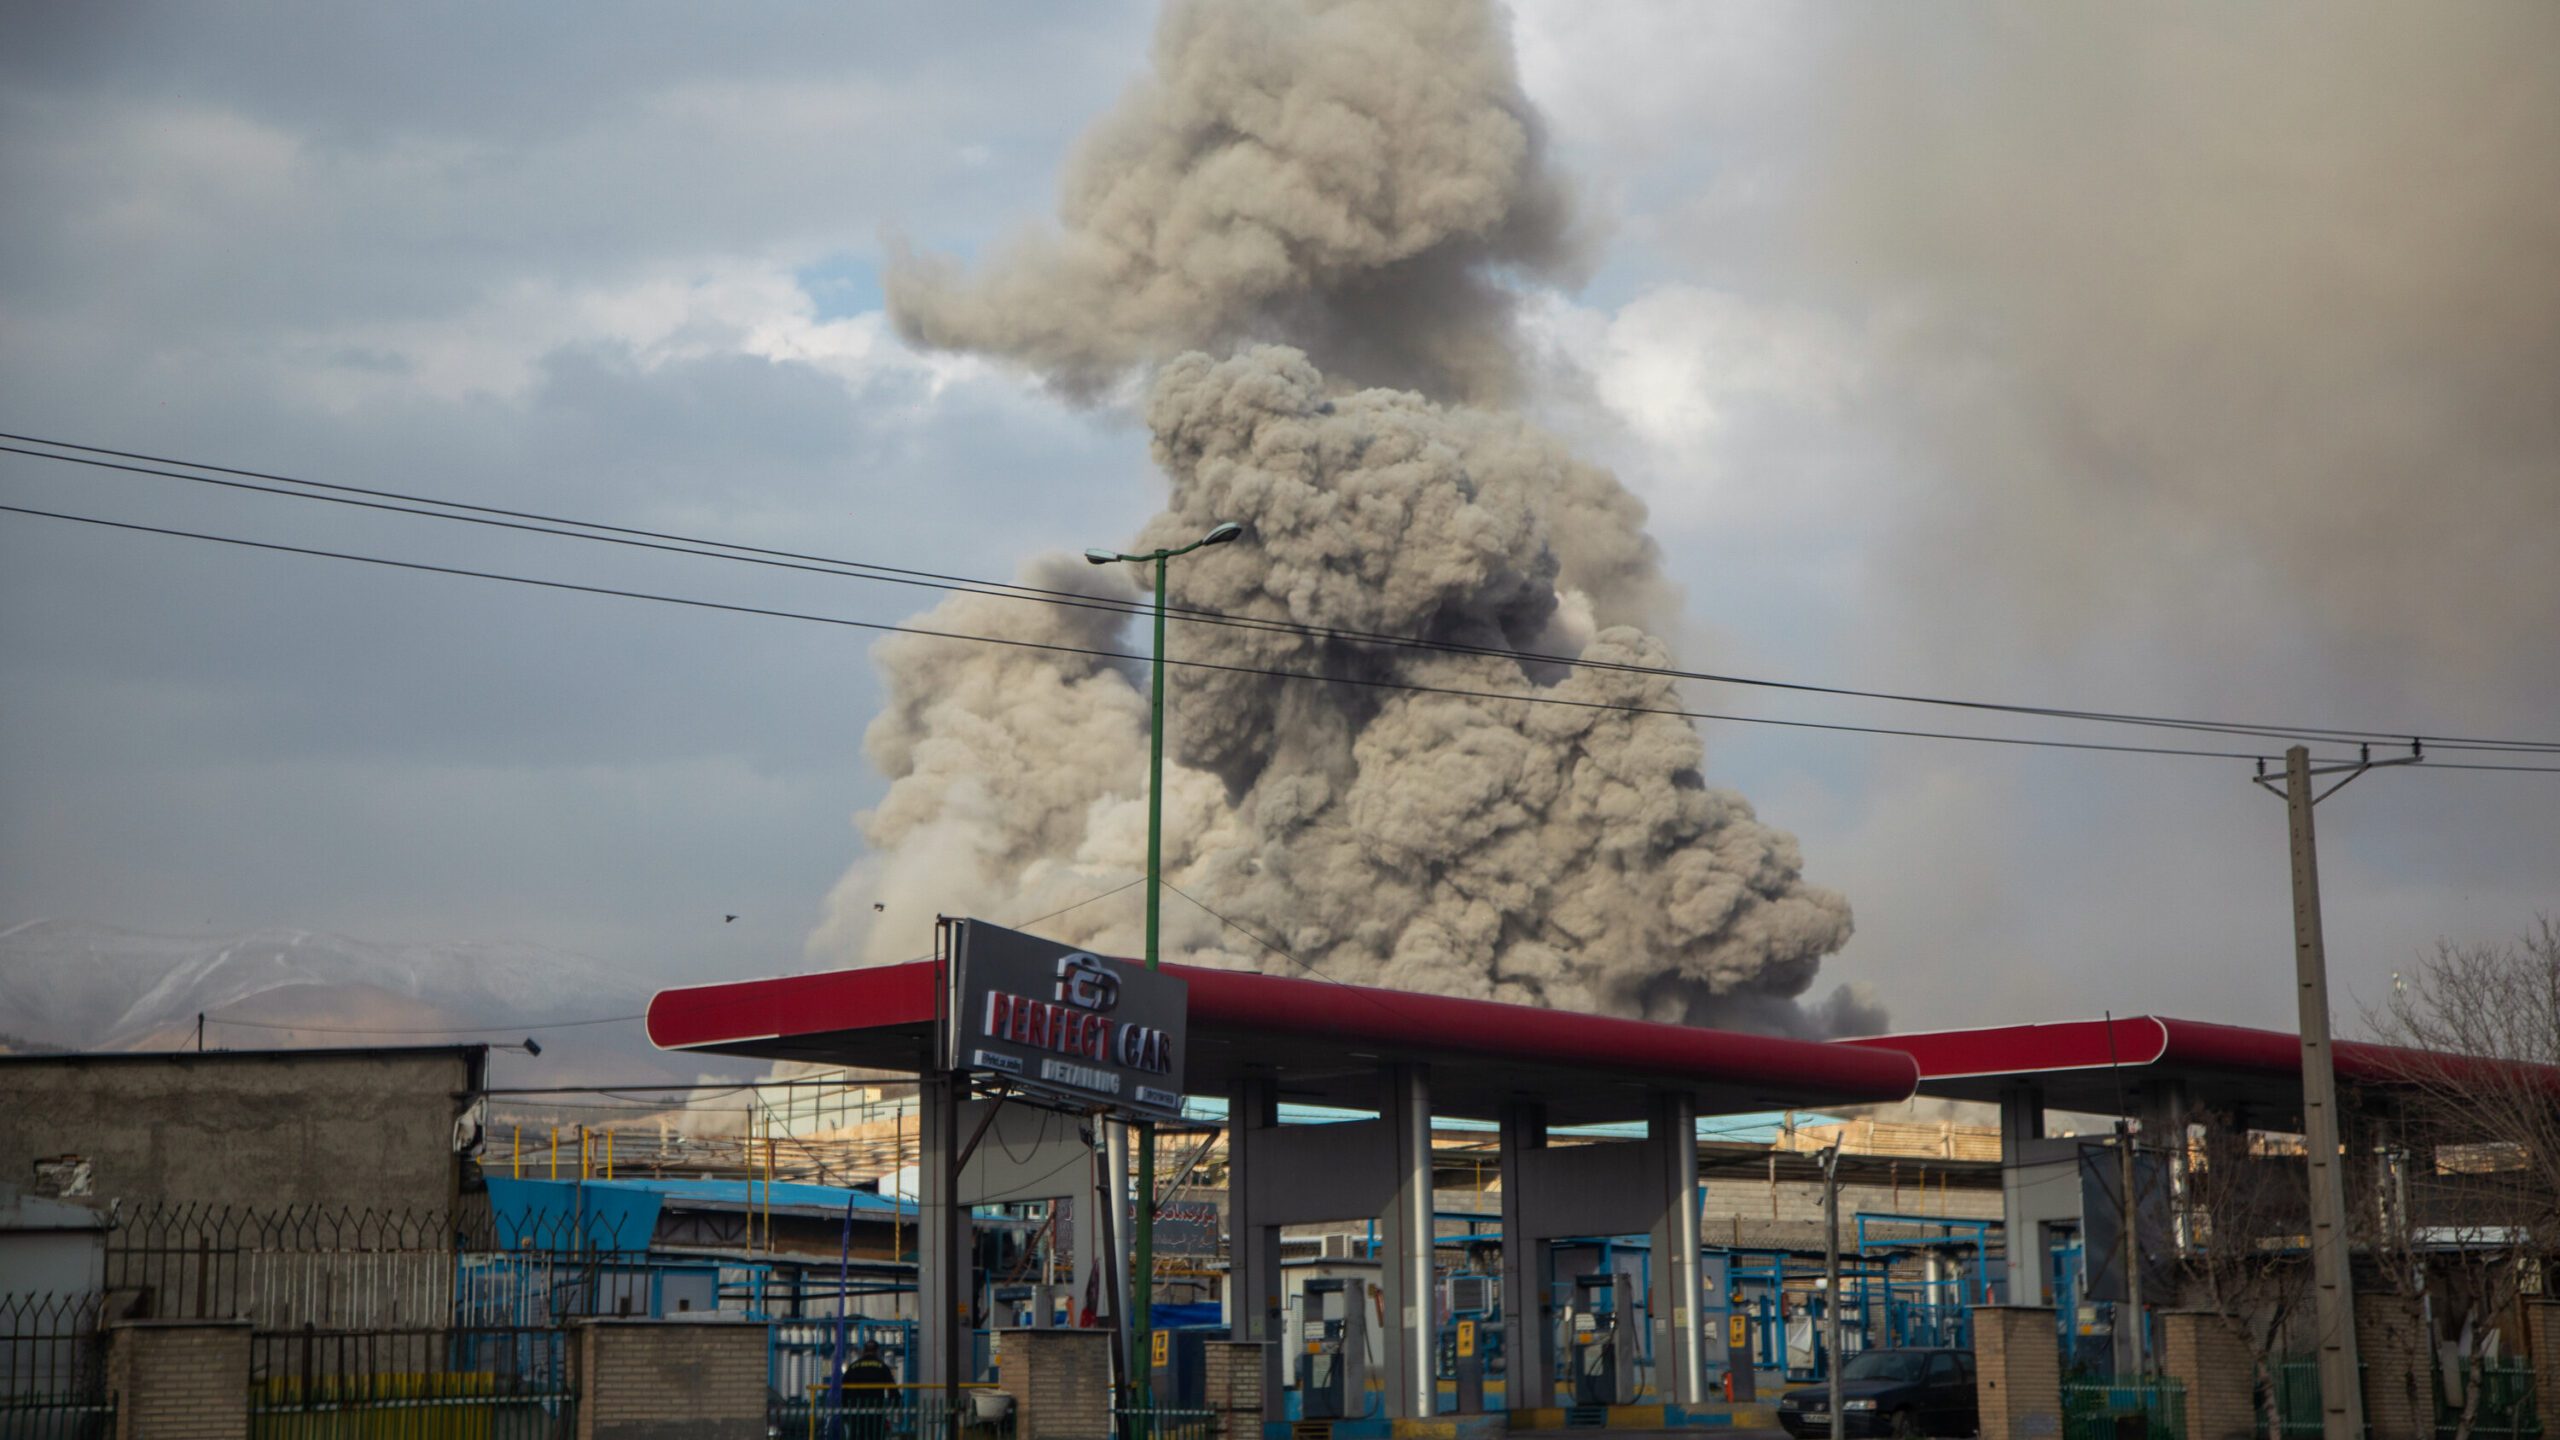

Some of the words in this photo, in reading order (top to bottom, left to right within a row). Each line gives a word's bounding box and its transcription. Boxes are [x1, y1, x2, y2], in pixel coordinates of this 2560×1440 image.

[984, 990, 1114, 1061] PERFECT
[1118, 1022, 1172, 1075] CAR
[1041, 1058, 1120, 1095] DETAILING
